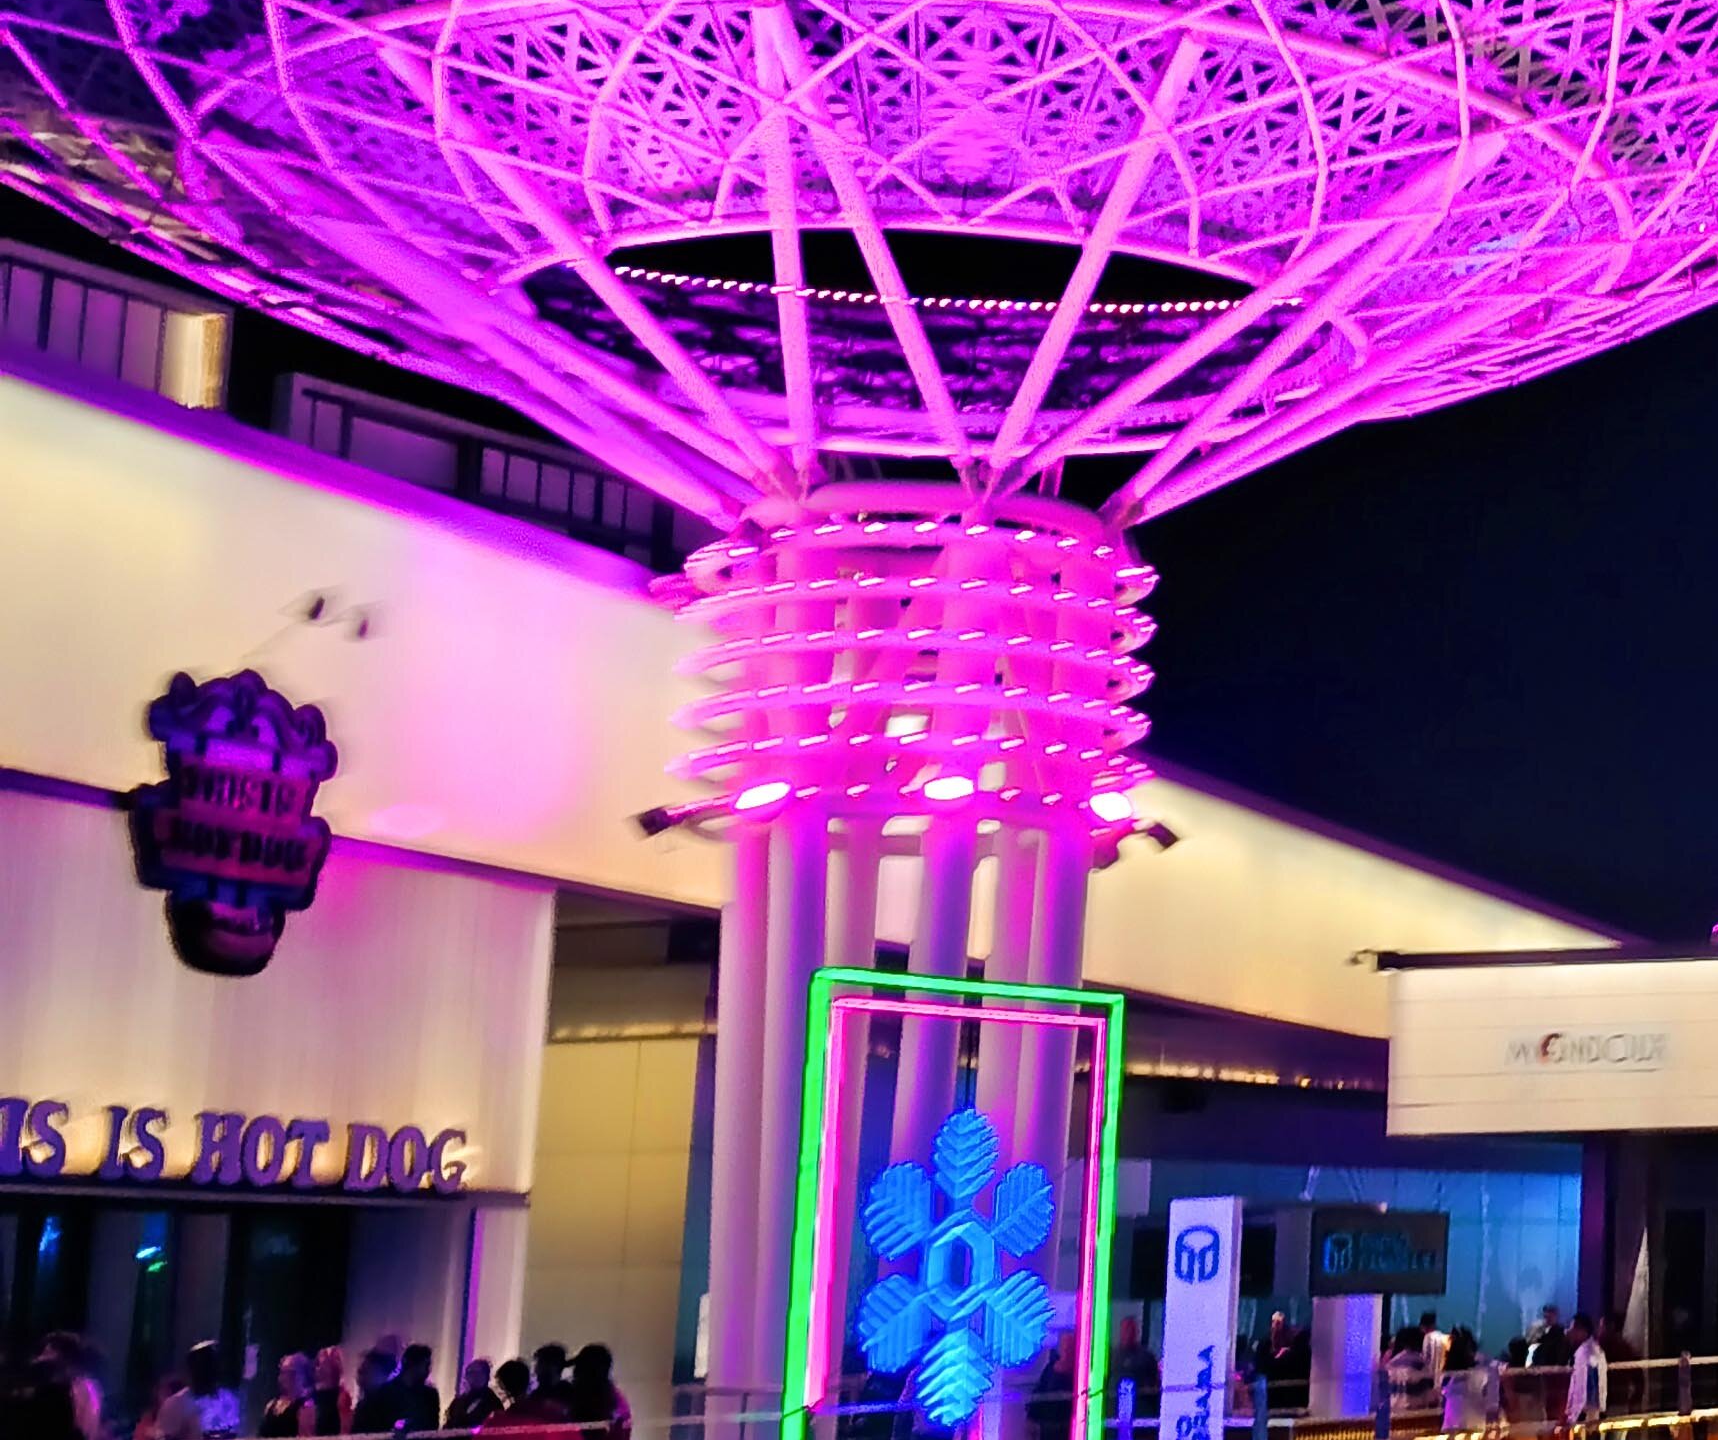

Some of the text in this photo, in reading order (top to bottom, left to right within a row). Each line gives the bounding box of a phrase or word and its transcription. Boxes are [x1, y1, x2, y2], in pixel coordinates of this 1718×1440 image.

[98, 1105, 168, 1179] IS
[191, 1110, 330, 1186] HOT
[343, 1122, 468, 1194] DOG
